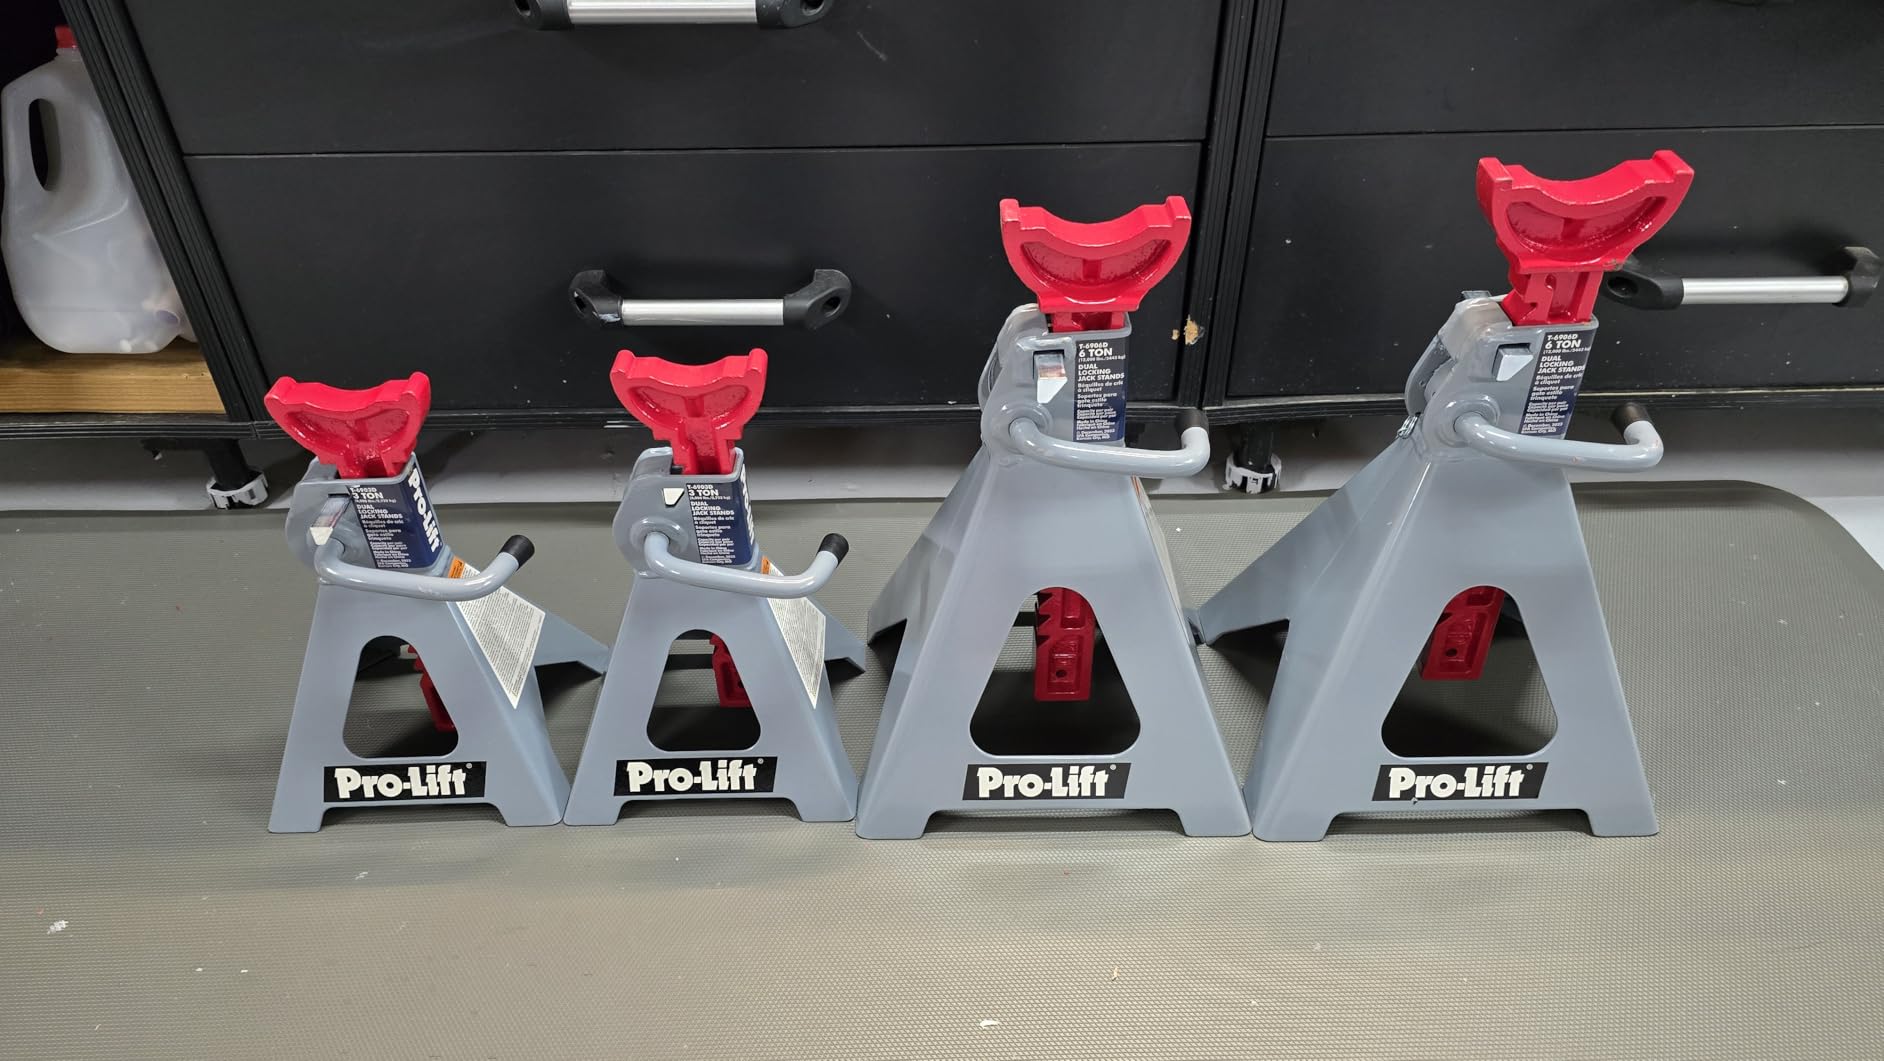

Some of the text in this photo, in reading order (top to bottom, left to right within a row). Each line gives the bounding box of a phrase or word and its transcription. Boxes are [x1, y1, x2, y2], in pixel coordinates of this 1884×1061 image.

[1089, 348, 1112, 356] TON
[1556, 340, 1581, 348] TON
[408, 467, 440, 553] Pro-Lift
[334, 764, 467, 799] Pro-Lift
[626, 759, 757, 793] Pro-Lift
[976, 765, 1109, 798] Pro-Lift
[1388, 765, 1525, 799] Pro-Lift
